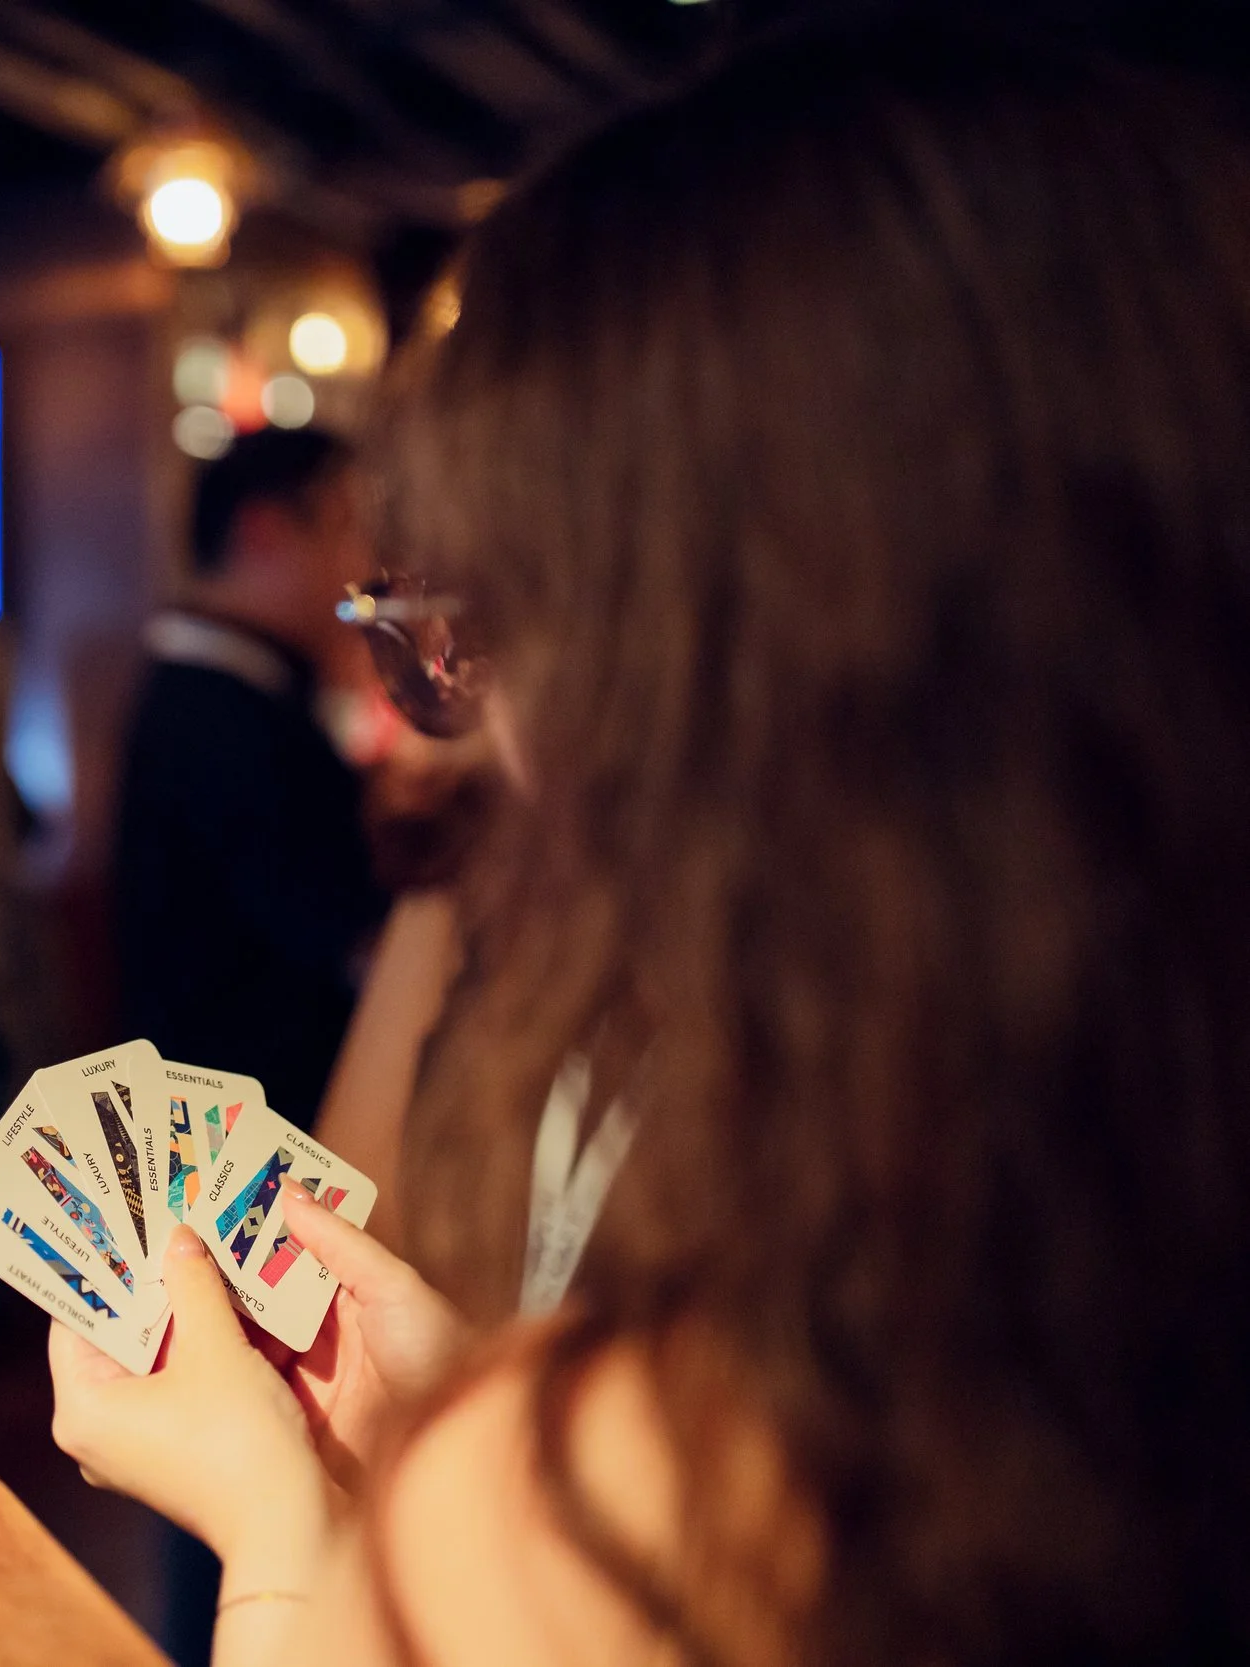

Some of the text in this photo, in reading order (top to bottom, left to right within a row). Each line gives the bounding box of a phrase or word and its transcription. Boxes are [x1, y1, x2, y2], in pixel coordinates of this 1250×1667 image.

[82, 1060, 116, 1077] LUXURY
[166, 1070, 223, 1089] ESSENTIALS
[2, 1104, 35, 1146] LIFESTYLE
[144, 1127, 159, 1192] ESSENTIALS
[286, 1133, 332, 1169] CLASSICS
[83, 1152, 110, 1195] LUXURY
[209, 1160, 235, 1202] CLASSICS
[41, 1216, 90, 1262] LIFESTYLE
[6, 1264, 95, 1330] WORLD OF HYATT
